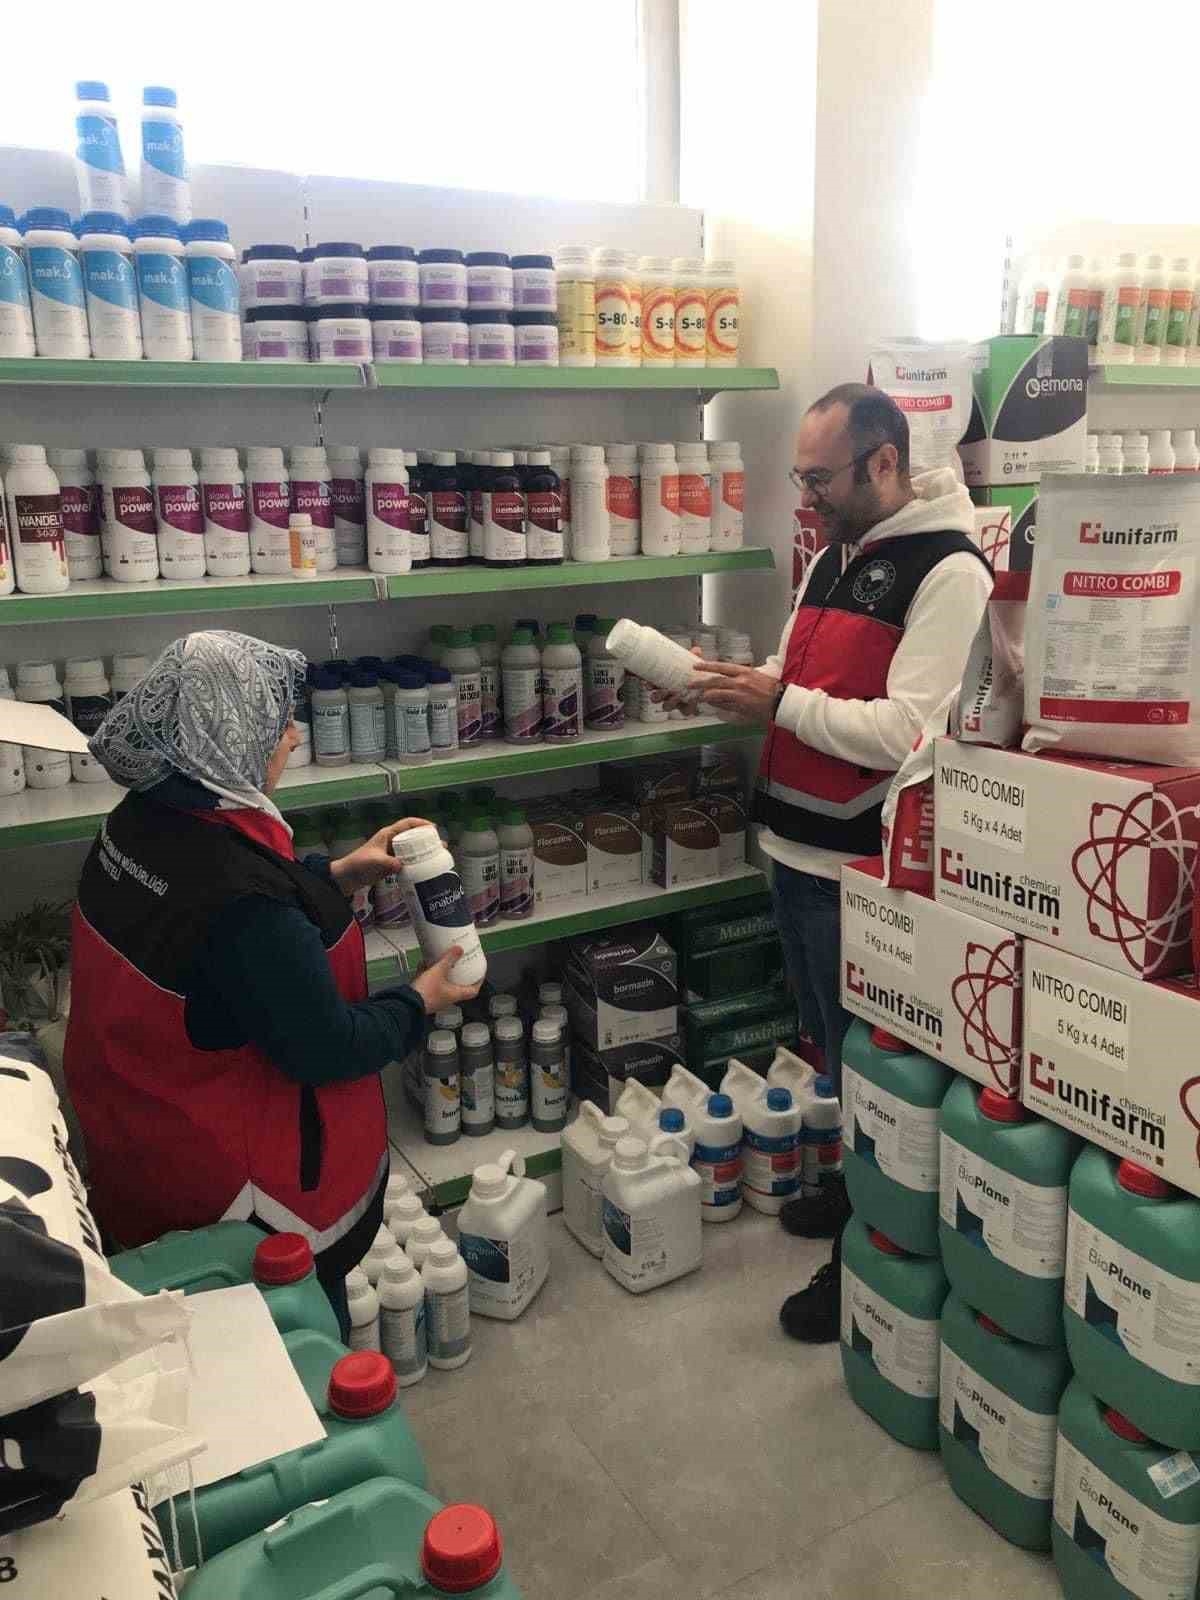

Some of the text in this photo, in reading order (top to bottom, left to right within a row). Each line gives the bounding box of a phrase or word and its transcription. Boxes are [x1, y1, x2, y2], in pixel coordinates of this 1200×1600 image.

[598, 312, 627, 325] S-80
[1103, 528, 1178, 545] unifarm
[1072, 575, 1170, 590] NITRO COMBI
[941, 766, 1025, 808] NITRO COMBI
[963, 810, 1023, 843] 5 Kg x 4 Adet
[966, 867, 1060, 920] unifarm
[1019, 874, 1061, 896] chemical
[846, 891, 914, 935] NITRO COMBI
[865, 931, 870, 944] 5
[889, 943, 894, 955] 4
[866, 982, 943, 1037] unifarm
[1032, 970, 1127, 1024] NITRO COMBI
[1058, 1019, 1125, 1060] 5 Kg x 4 Adet
[1058, 1079, 1166, 1150] unifarm
[1119, 1097, 1167, 1126] chemical
[958, 1165, 1011, 1207] BioPlane
[1088, 1247, 1152, 1301] BioPlane
[1079, 1476, 1140, 1535] BioPlane
